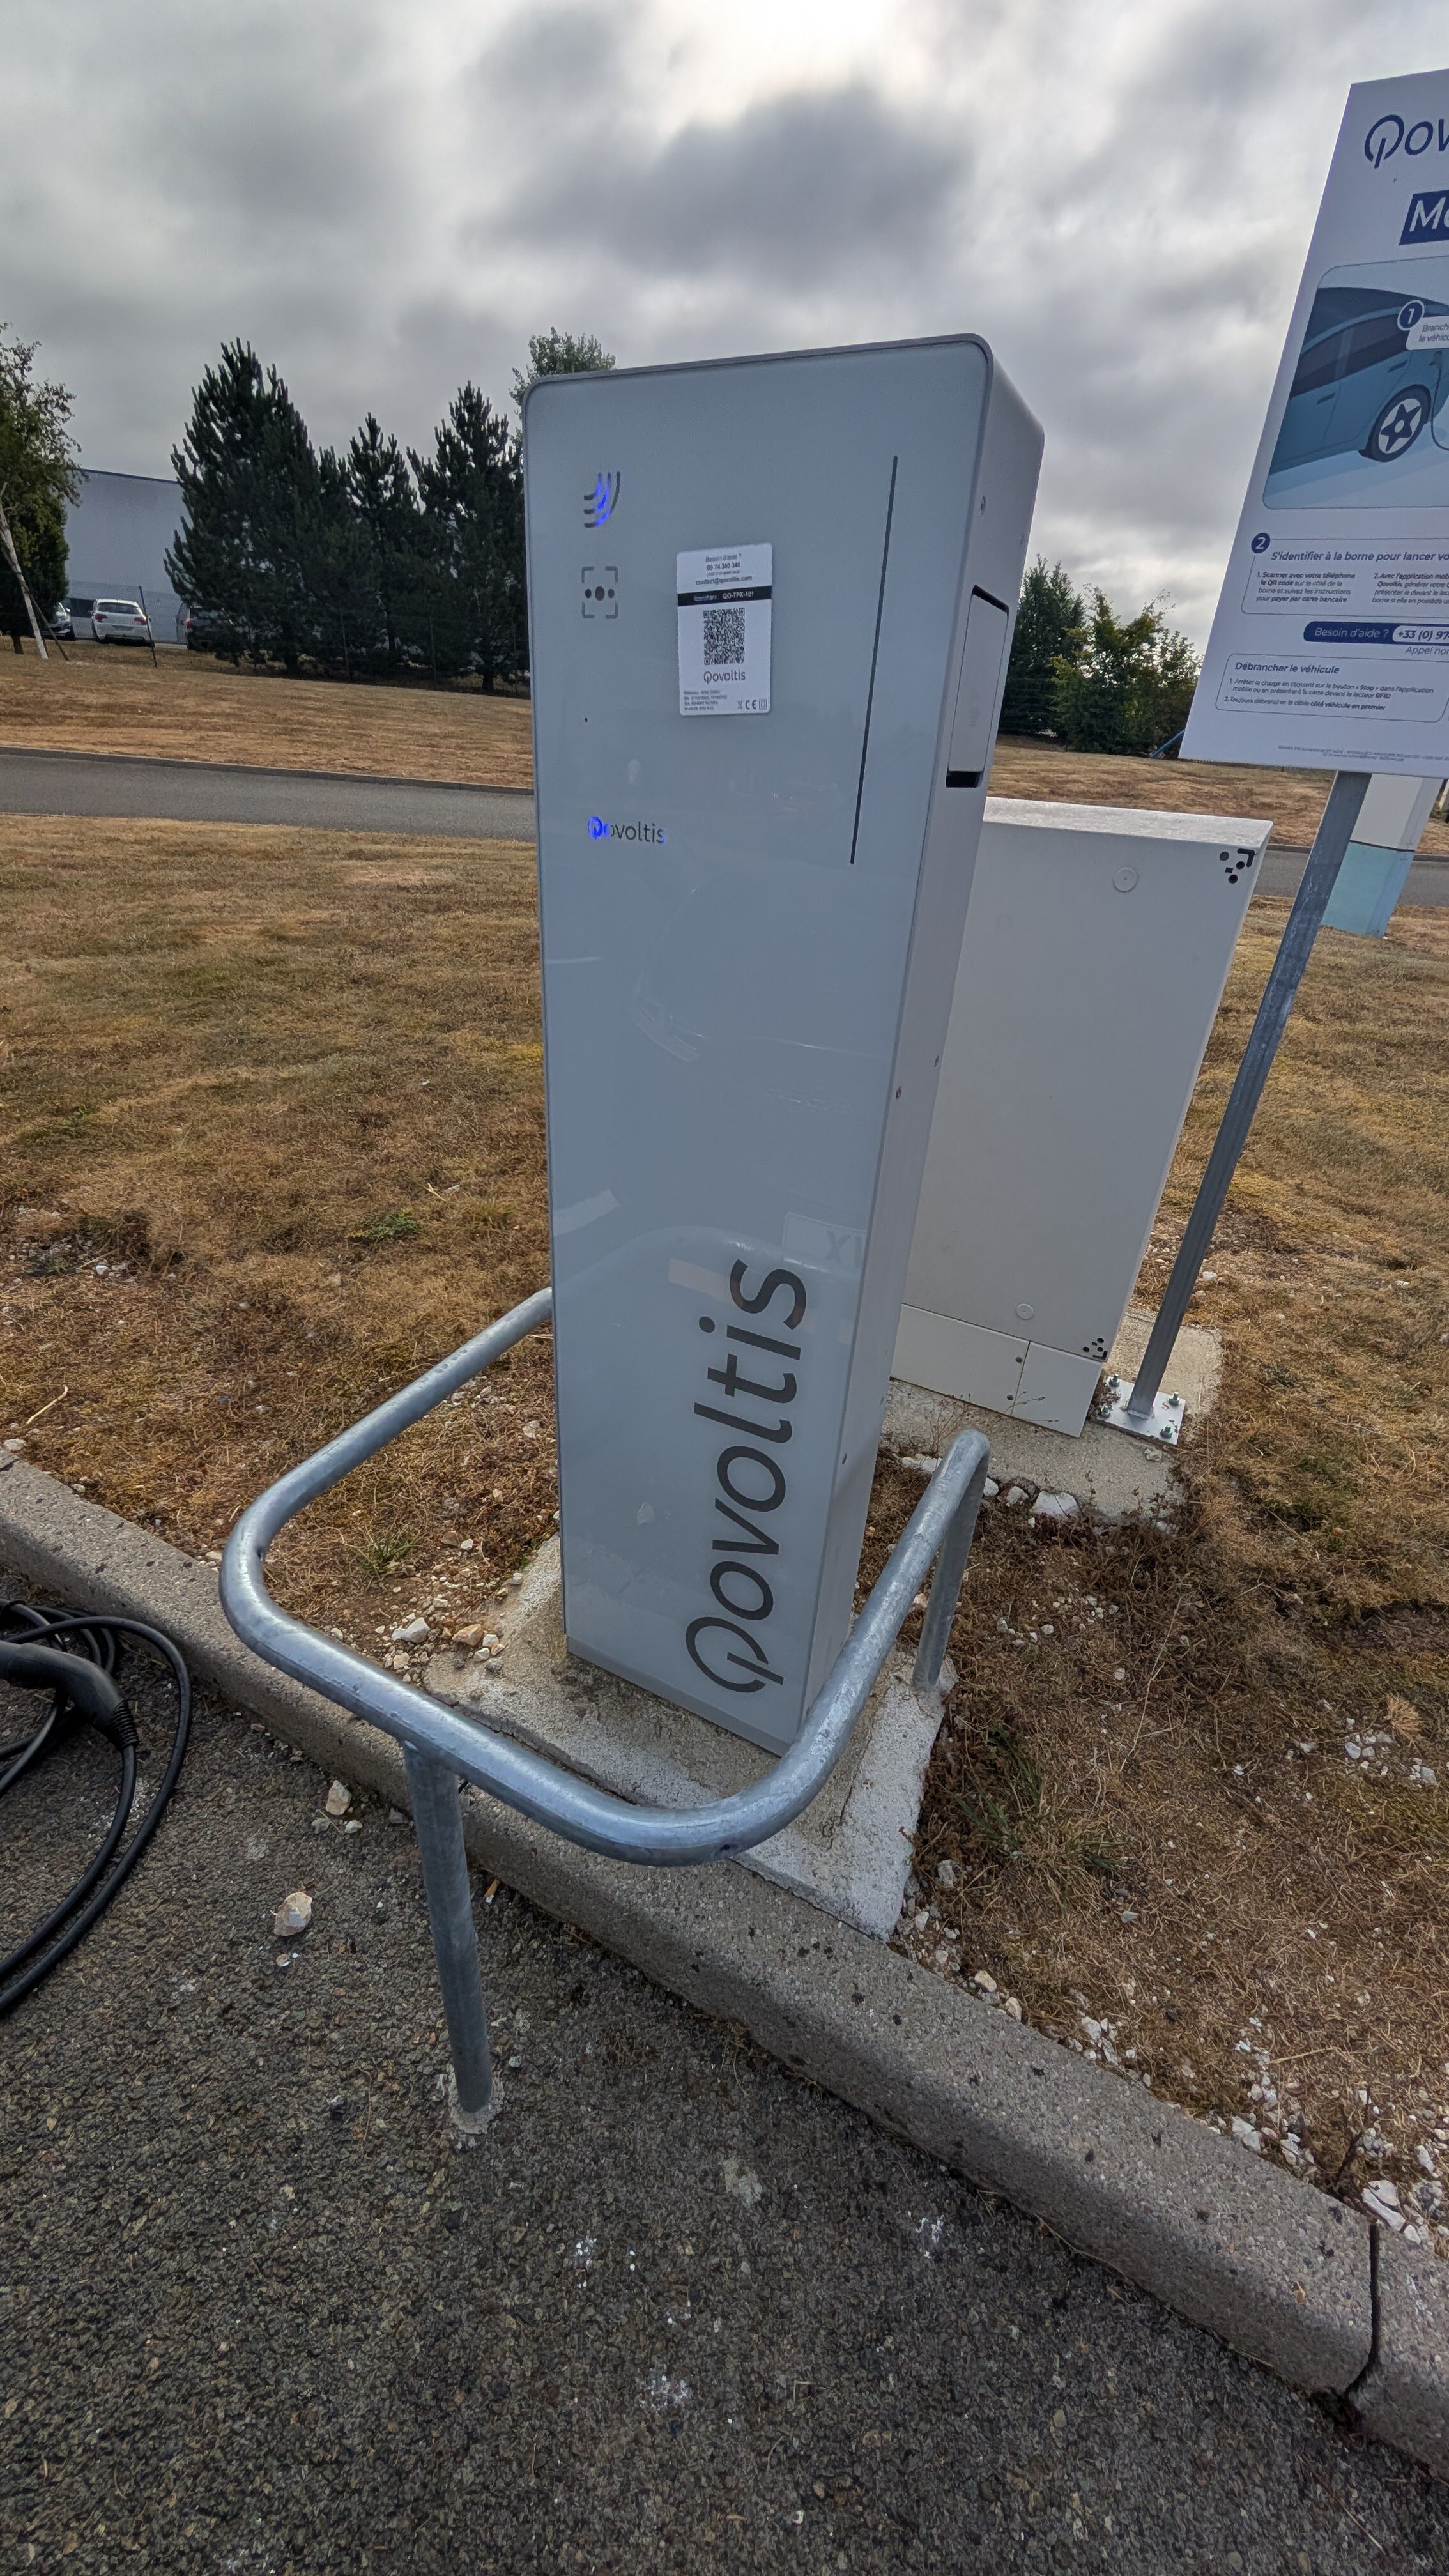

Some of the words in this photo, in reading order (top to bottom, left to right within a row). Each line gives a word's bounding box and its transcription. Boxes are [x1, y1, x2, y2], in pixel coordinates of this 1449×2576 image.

[1409, 196, 1449, 232] M
[1407, 308, 1415, 324] 1
[1418, 334, 1425, 342] le
[1255, 537, 1266, 549] 2
[1271, 551, 1323, 560] S'identifier
[1325, 552, 1331, 560] à
[1333, 552, 1341, 560] la
[1344, 552, 1374, 560] borne
[1376, 554, 1401, 562] pour
[1403, 552, 1436, 560] lancer
[1314, 627, 1347, 637] Besoin
[1350, 628, 1380, 638] d'aide
[1384, 629, 1389, 638] ?
[1398, 630, 1416, 639] +33
[1418, 631, 1432, 641] (0)
[1436, 631, 1449, 640] 97
[1406, 646, 1432, 655] Appel
[1235, 662, 1288, 672] Débrancher
[1290, 664, 1298, 672] le
[1301, 664, 1340, 674] véhicule
[703, 670, 746, 684] Qovoltis
[685, 1259, 808, 1693] Qovoltis
